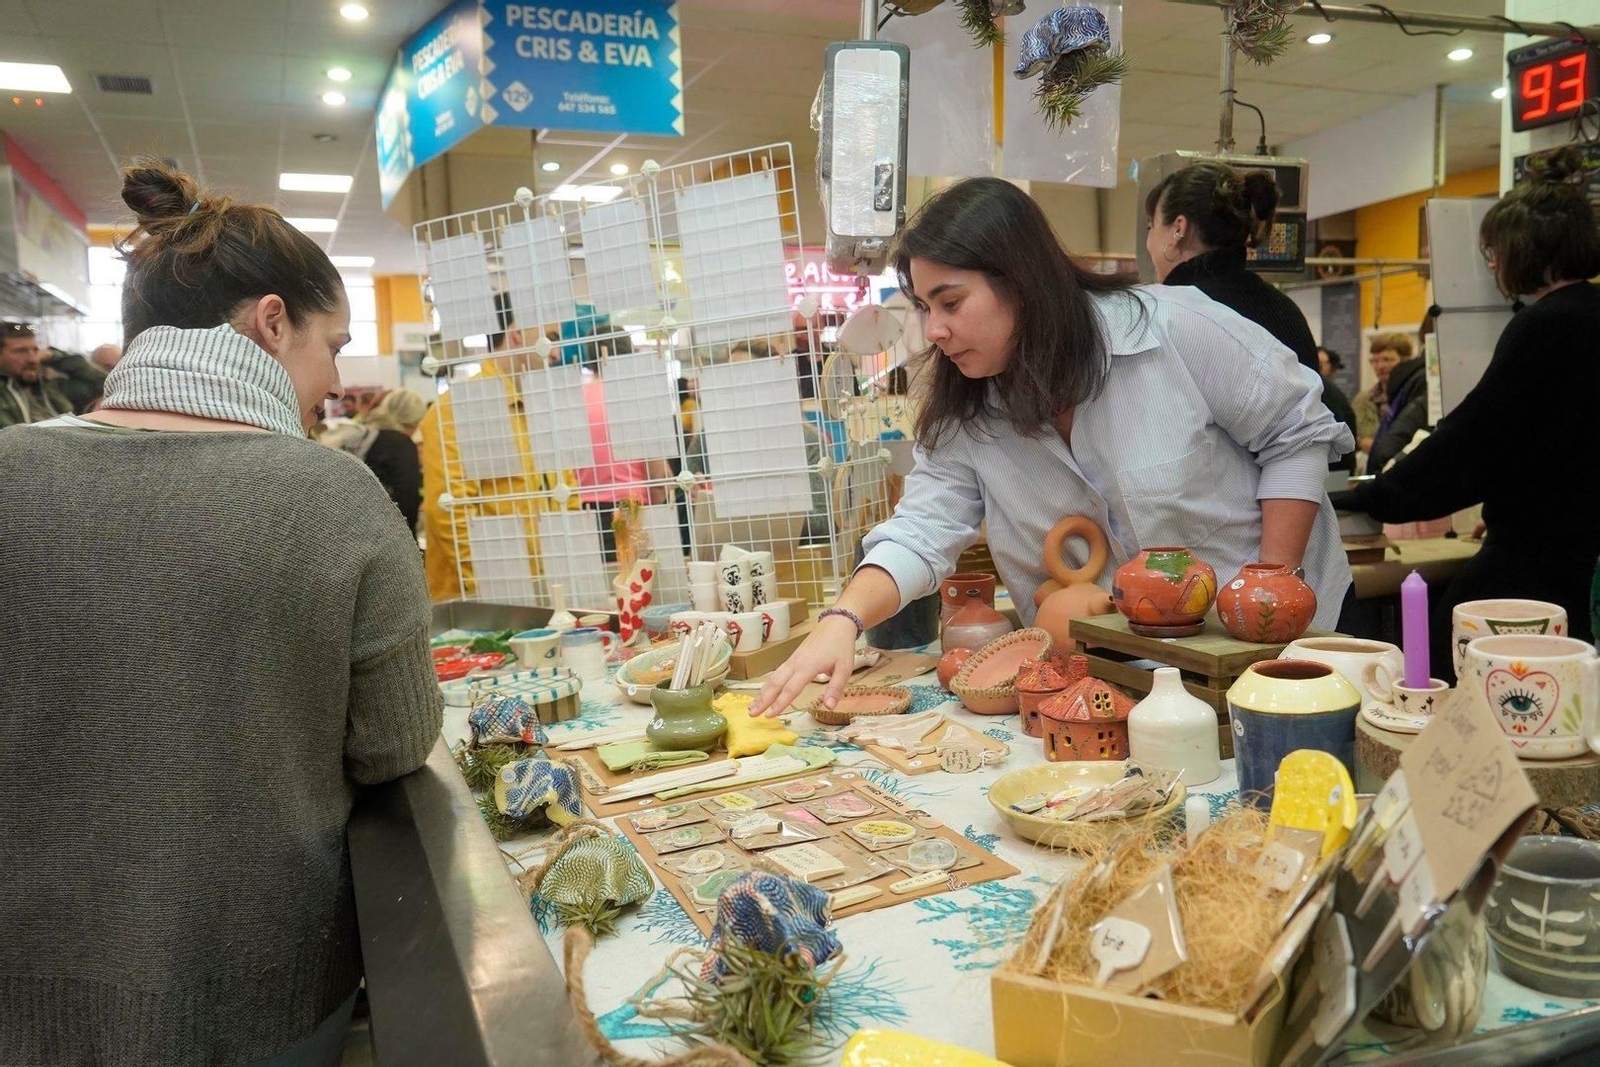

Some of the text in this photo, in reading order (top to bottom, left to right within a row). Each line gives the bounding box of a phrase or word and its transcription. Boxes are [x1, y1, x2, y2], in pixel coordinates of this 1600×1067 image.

[506, 4, 660, 40] PESCADERÍA
[515, 35, 653, 68] CRIS & EVA
[1522, 53, 1586, 120] 93
